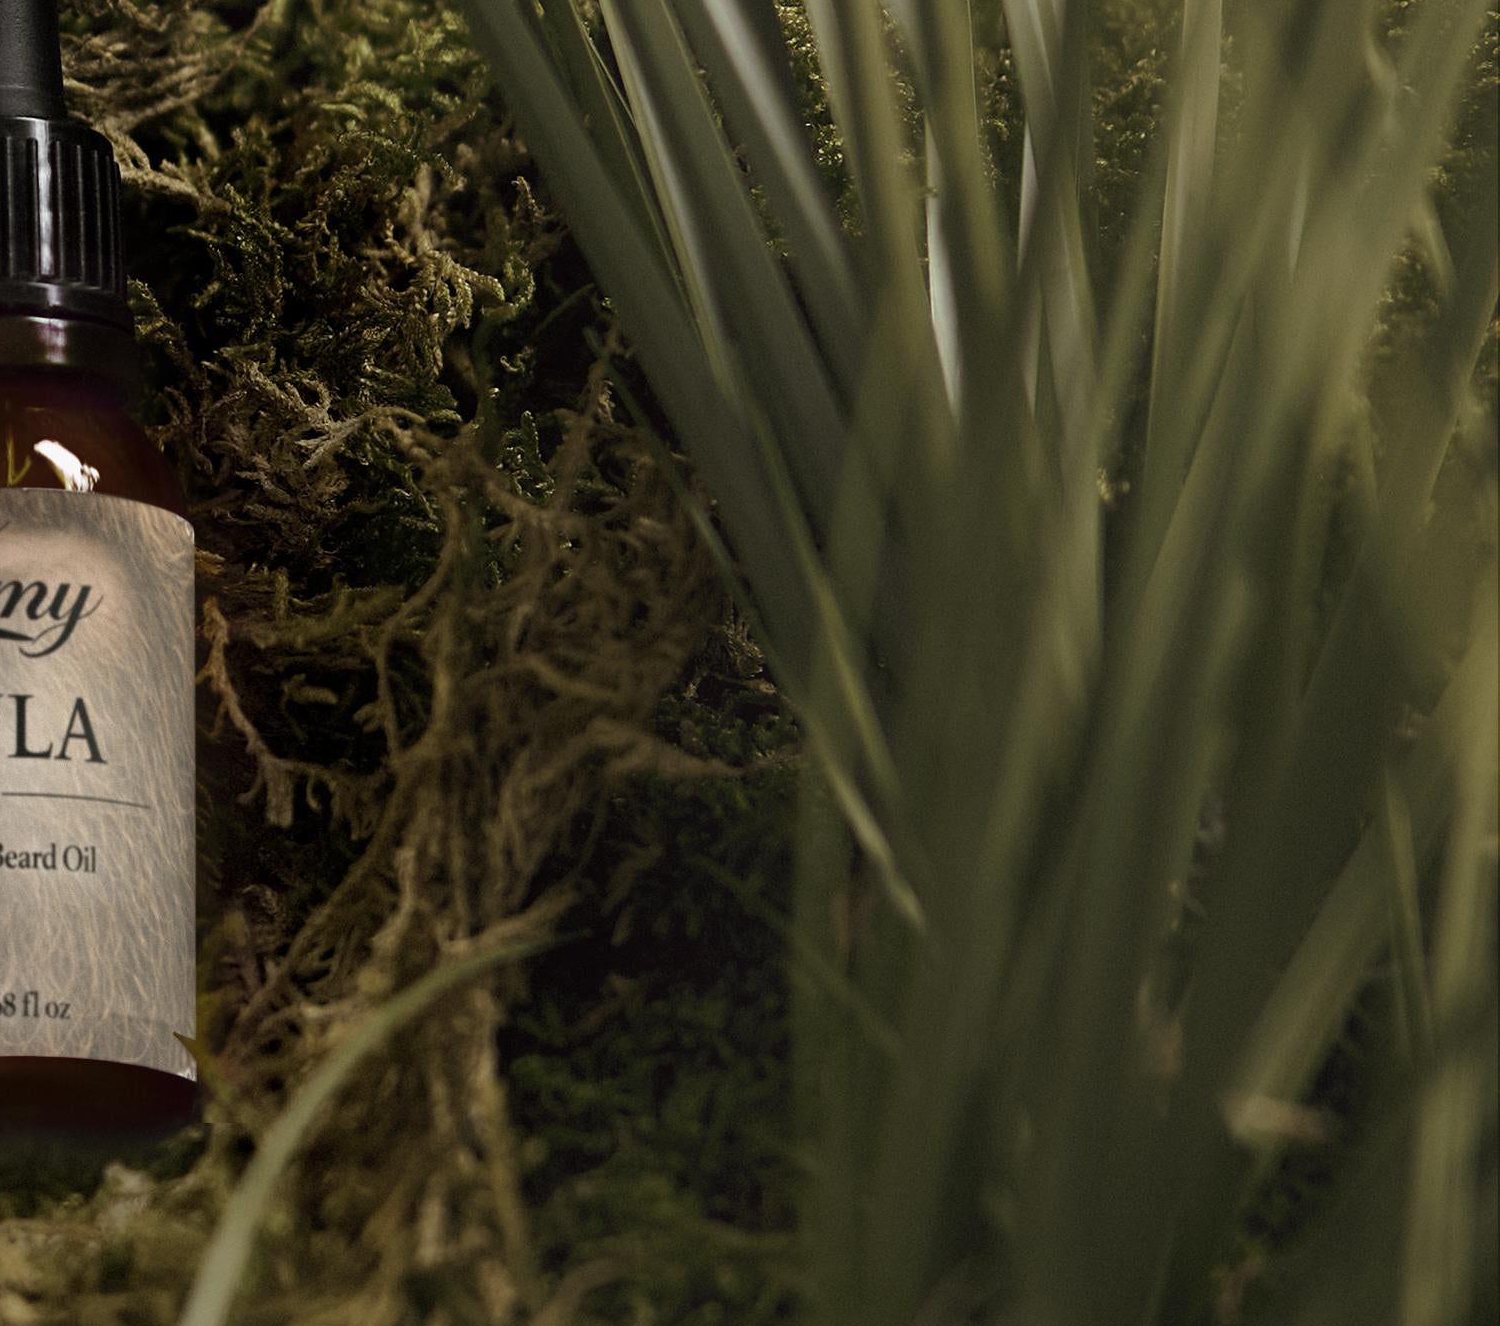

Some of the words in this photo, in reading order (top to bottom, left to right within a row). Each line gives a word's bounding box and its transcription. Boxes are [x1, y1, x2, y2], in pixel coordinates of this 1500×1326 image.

[62, 845, 97, 873] Oil
[22, 991, 41, 1018] fl
[45, 1002, 71, 1020] oz
